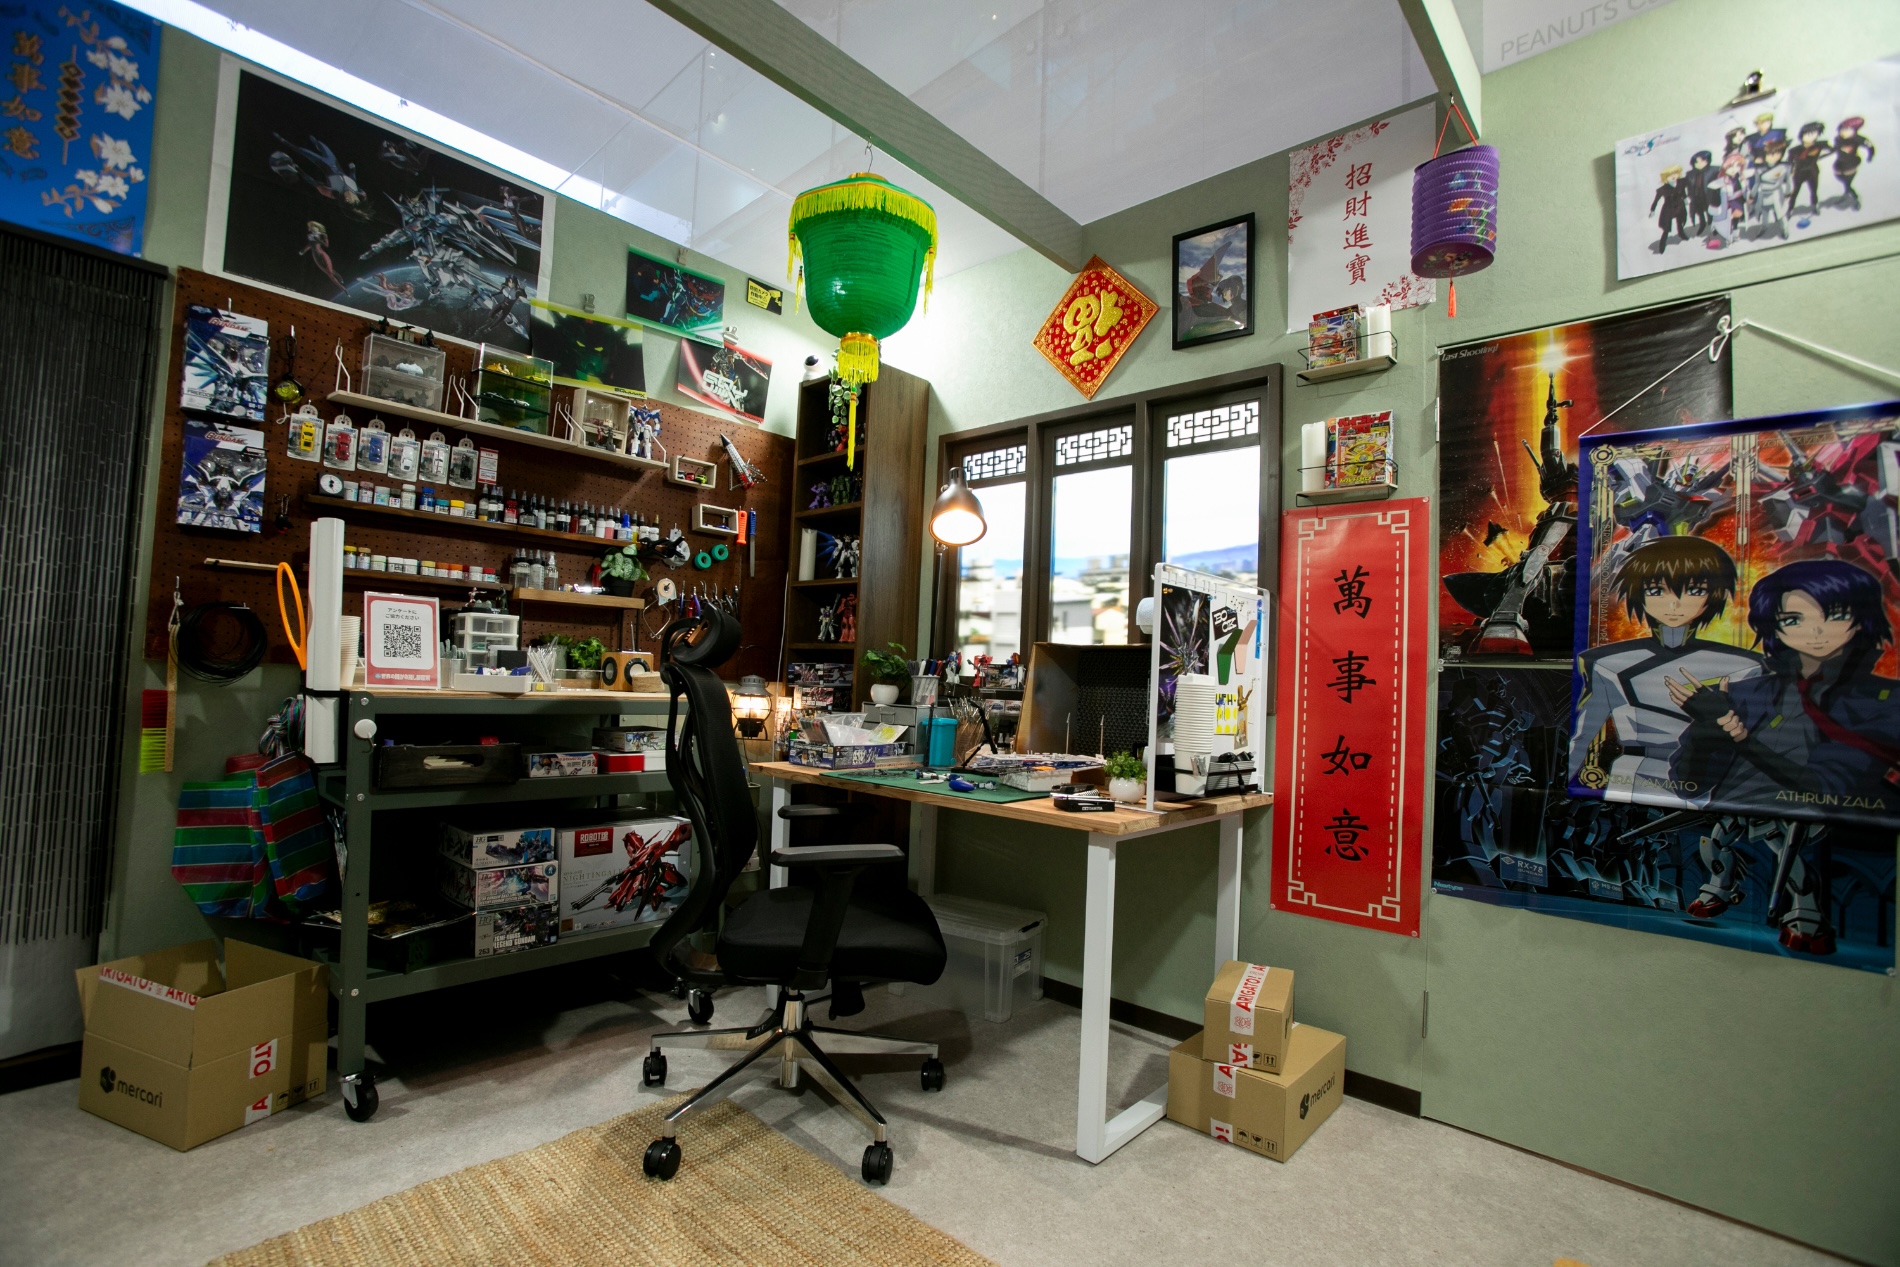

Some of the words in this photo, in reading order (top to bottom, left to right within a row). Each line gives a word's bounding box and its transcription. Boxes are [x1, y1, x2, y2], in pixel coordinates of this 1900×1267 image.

[1500, 0, 1619, 61] PEANUTS
[1343, 162, 1374, 286] 招財進寶
[208, 317, 251, 331] GUNDAM
[1442, 352, 1458, 361] Last
[1459, 343, 1499, 359] Shooting!
[204, 431, 247, 445] GUNDAM
[385, 613, 420, 621] ご協力ください
[387, 607, 417, 615] アンケートに
[1320, 564, 1377, 862] 萬事如意
[1606, 774, 1633, 786] KIRA
[1636, 776, 1698, 792] YAMATO
[1776, 789, 1838, 806] ATHRUN
[1842, 795, 1887, 810] ZALA
[1517, 860, 1543, 874] RX-78
[494, 938, 513, 949] LEGEND
[514, 935, 536, 946] GUNDAM
[1236, 975, 1262, 1013] ARIGATO!
[117, 1079, 163, 1109] mercari
[1310, 1072, 1336, 1107] mercari
